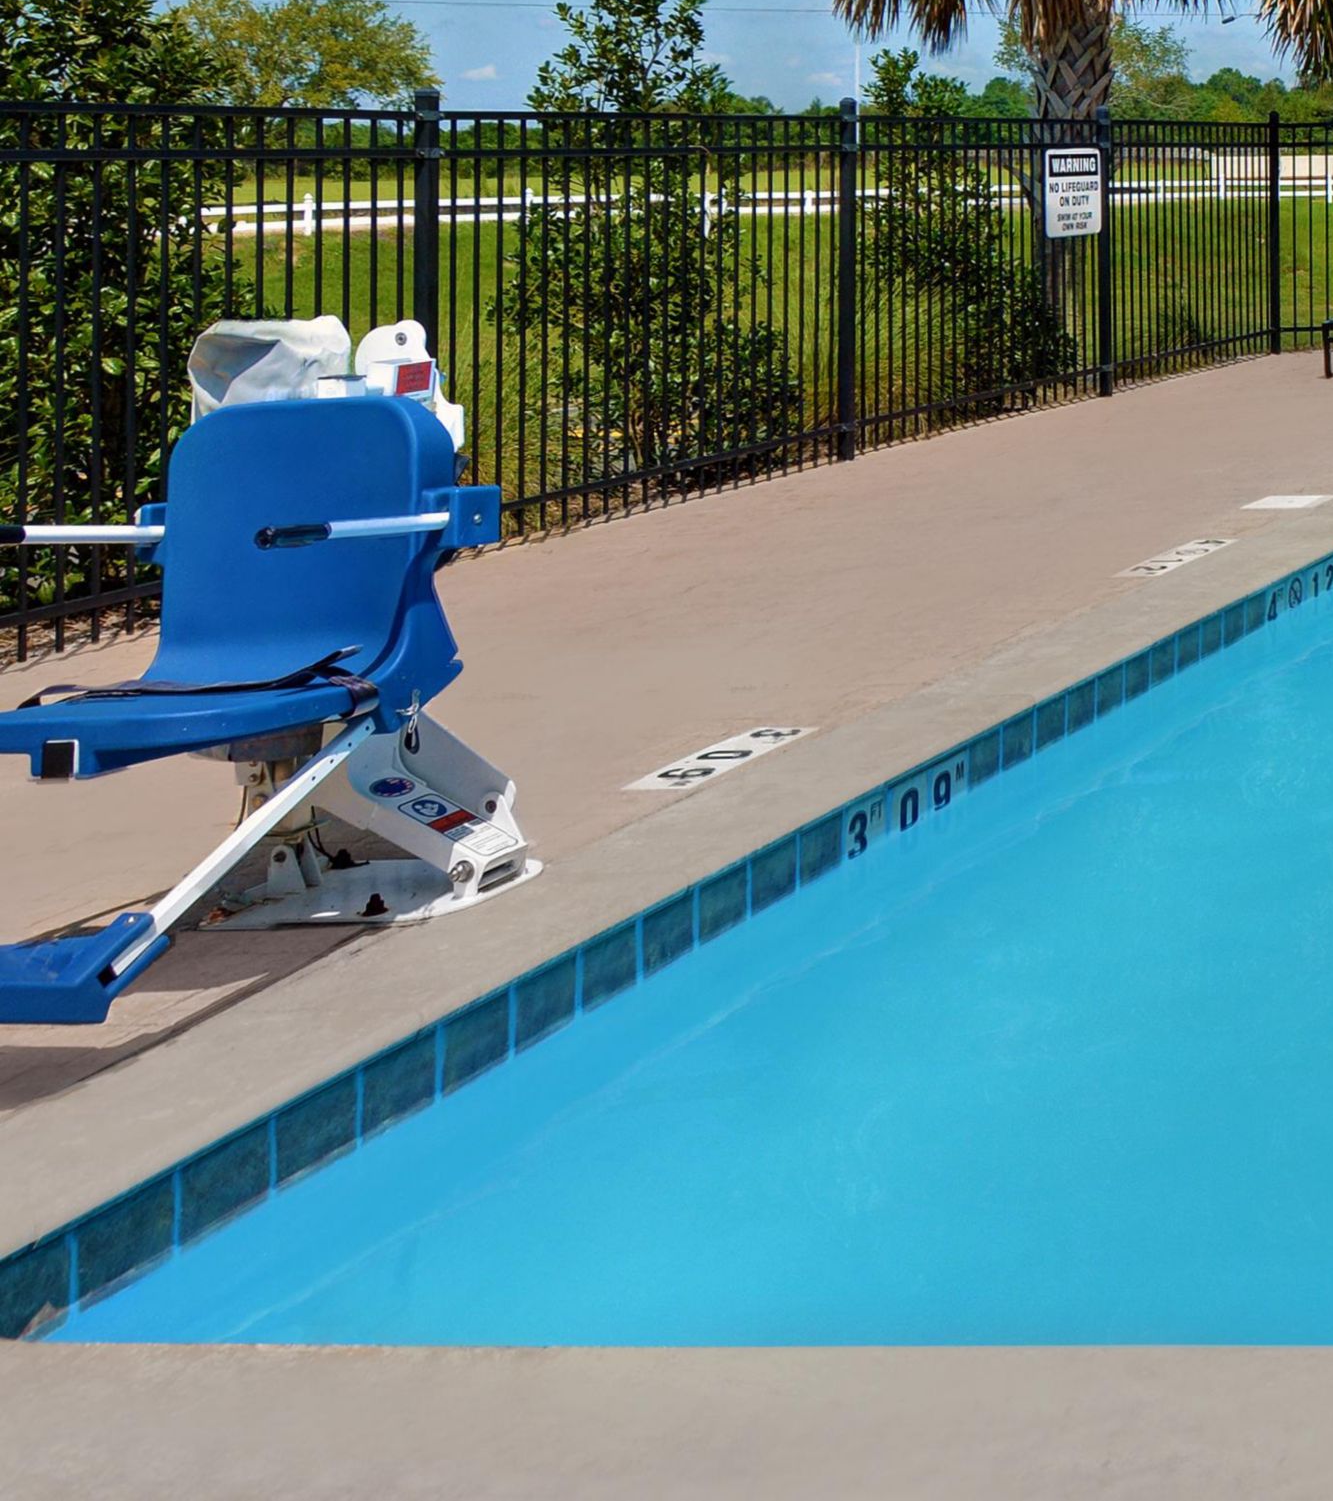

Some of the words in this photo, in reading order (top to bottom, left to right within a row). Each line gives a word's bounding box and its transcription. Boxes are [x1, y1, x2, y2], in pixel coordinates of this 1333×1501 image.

[1051, 157, 1096, 173] WARNING
[1049, 182, 1059, 193] NO
[1061, 180, 1099, 193] LIFEGUARD
[1059, 196, 1070, 207] ON
[1072, 195, 1090, 206] DUTY
[1057, 213, 1071, 222] SWIM
[1079, 211, 1093, 220] YOUR
[1062, 223, 1074, 231] OWN
[1075, 222, 1088, 230] RISK
